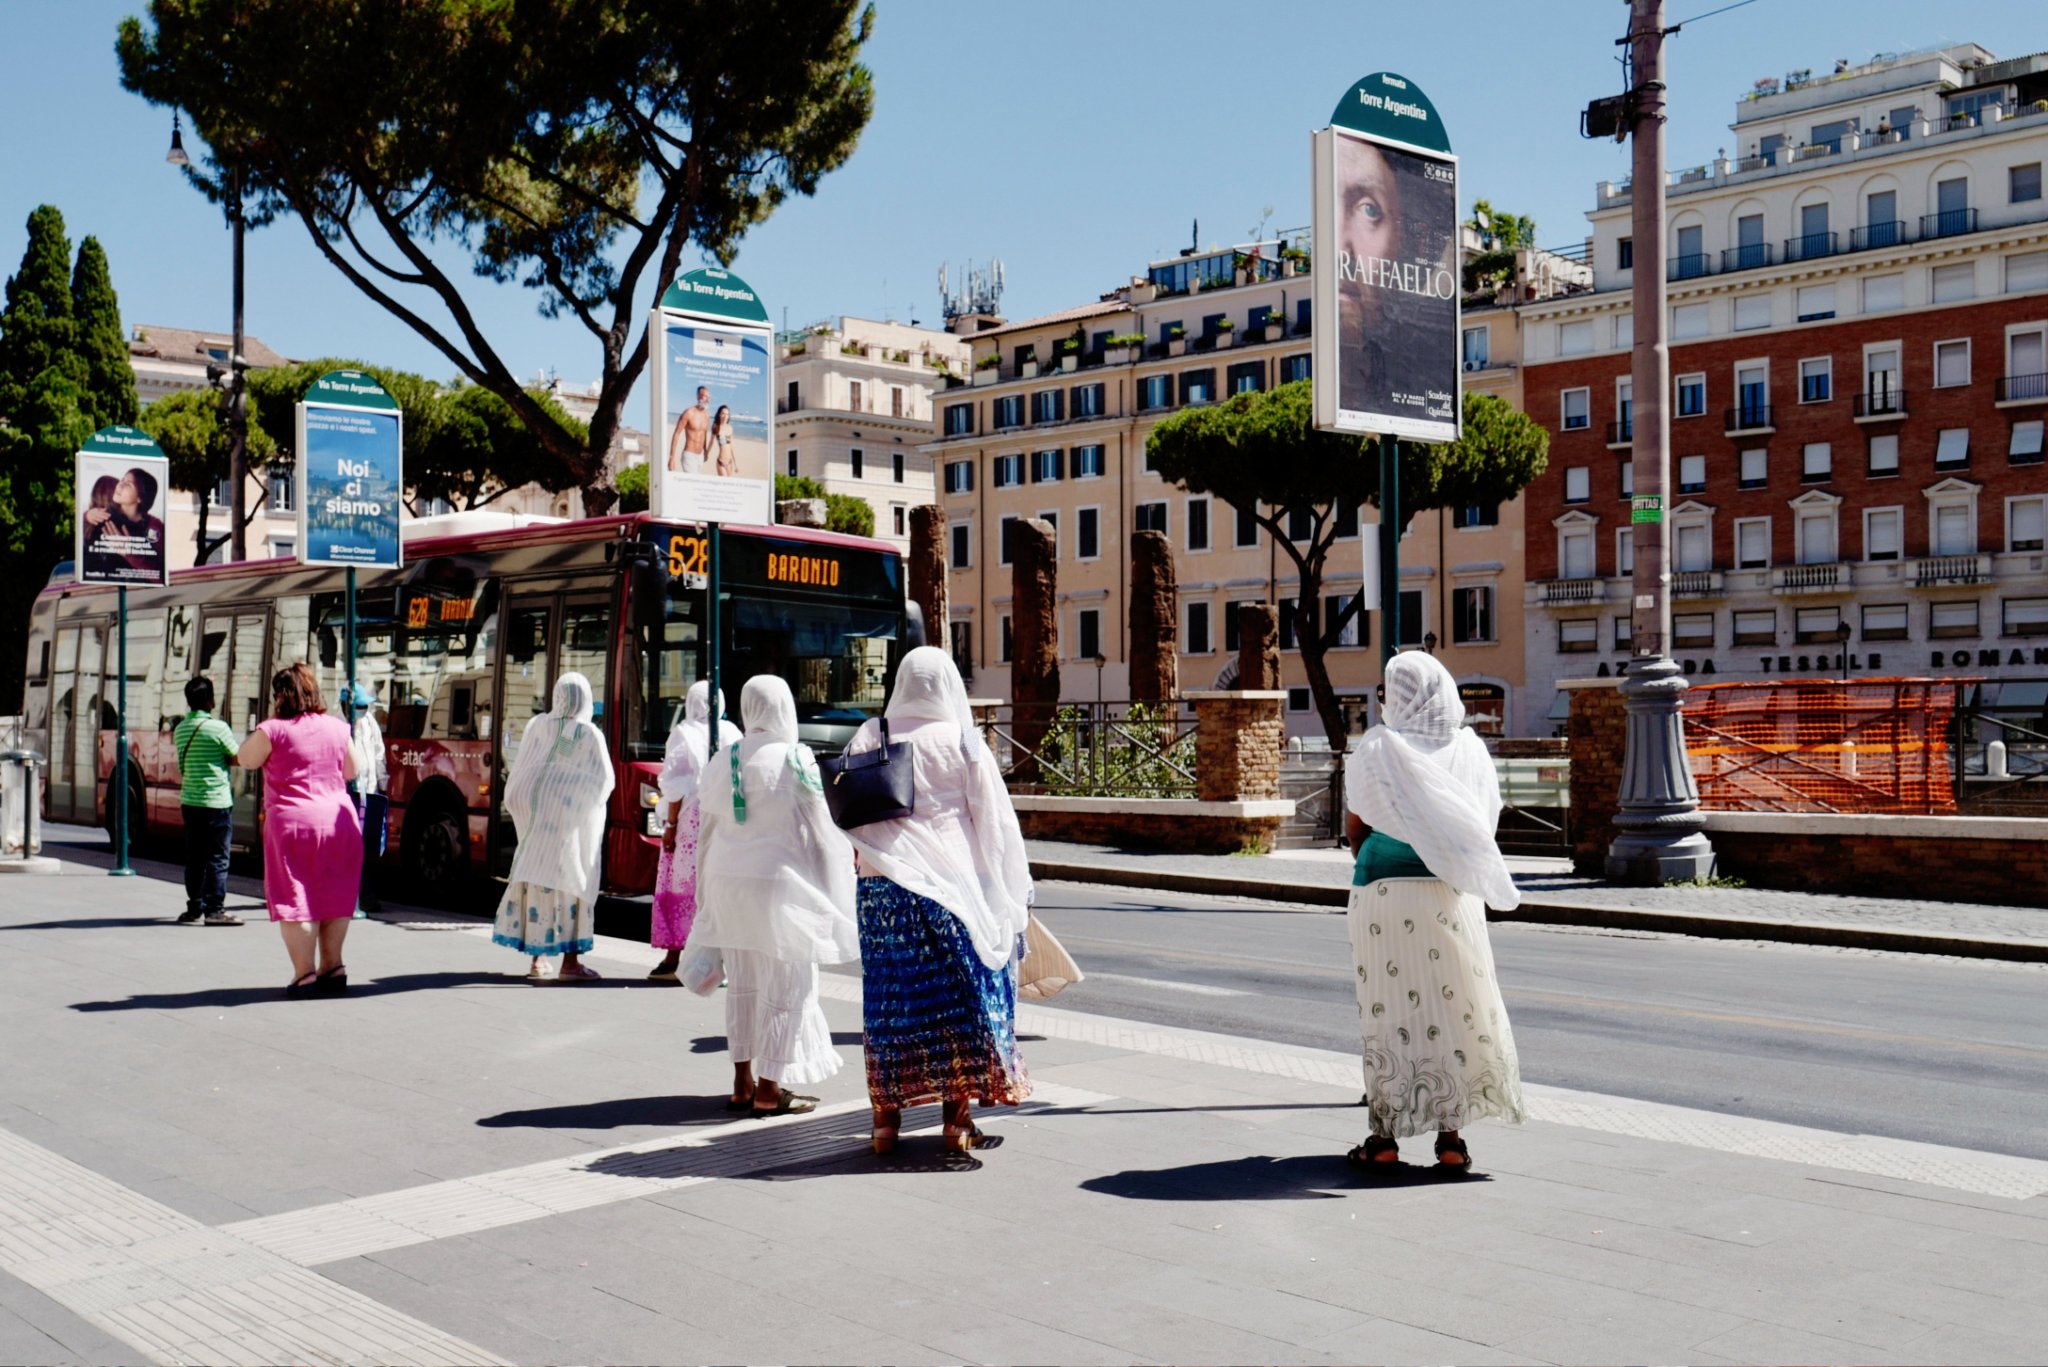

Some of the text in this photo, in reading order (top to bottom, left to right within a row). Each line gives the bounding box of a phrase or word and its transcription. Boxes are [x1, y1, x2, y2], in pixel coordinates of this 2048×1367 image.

[1382, 73, 1406, 89] fermata
[1359, 88, 1427, 121] Torre Argentina
[1339, 250, 1455, 300] RAFFAELLO
[677, 280, 754, 302] Via Torre Argentina
[318, 380, 385, 395] Via Torre Argentina
[1428, 390, 1453, 401] Scuderie
[1428, 406, 1454, 418] Quirinale
[95, 434, 154, 446] Via Torre Argentina
[337, 458, 369, 478] Noi
[345, 478, 361, 496] ci
[325, 495, 381, 517] siamo
[768, 553, 839, 587] BARONIO
[408, 597, 429, 627] 628
[1597, 658, 1717, 677] AZDA
[1760, 653, 1882, 673] TESSILE
[402, 749, 425, 766] atac
